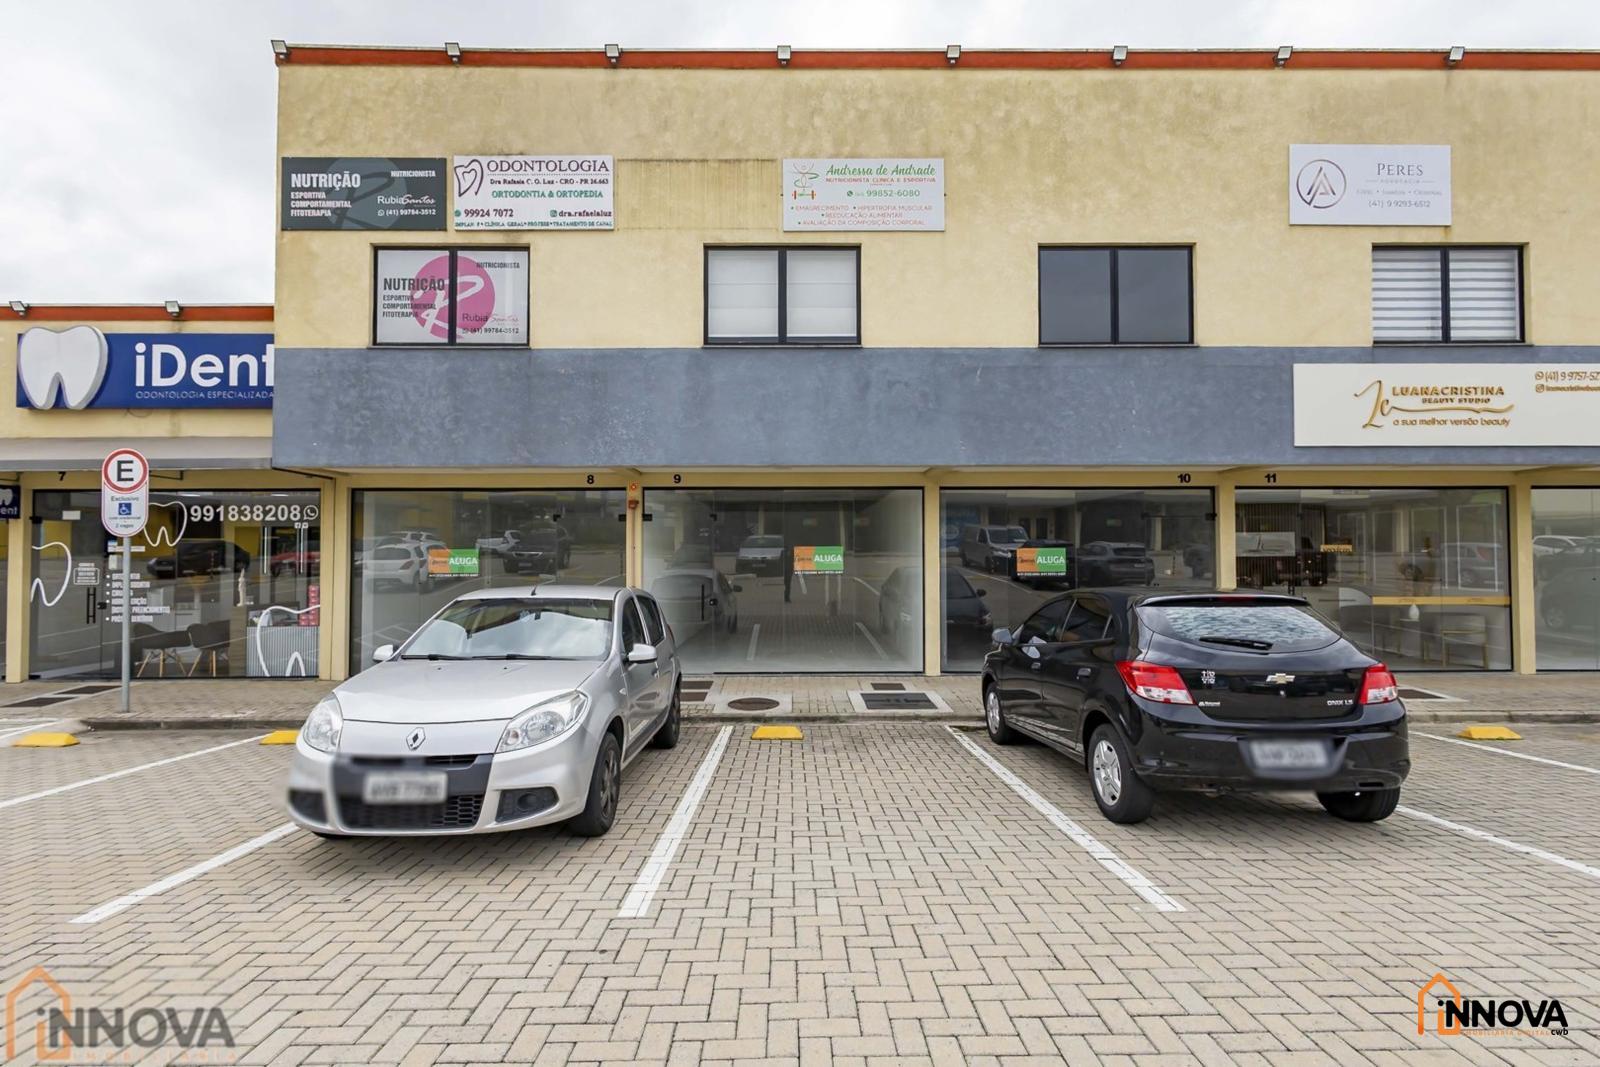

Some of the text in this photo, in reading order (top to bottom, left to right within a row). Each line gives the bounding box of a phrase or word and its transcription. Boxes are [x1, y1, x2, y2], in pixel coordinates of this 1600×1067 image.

[487, 160, 609, 172] ODONTOLOGIA
[826, 164, 936, 176] Andressa de Andrade
[1377, 163, 1423, 176] PERES
[291, 171, 361, 191] NUTRIÇÃO
[290, 192, 326, 200] ESPORTIVA
[492, 190, 603, 198] ORTODONTIA & ORTOPEDIA
[866, 189, 920, 197] 99852-6080
[401, 194, 436, 204] Santos
[386, 208, 398, 216] (41)
[464, 209, 514, 218] 99924 7072
[384, 276, 444, 293] NUTRIÇÃO
[462, 313, 488, 322] Rubia
[134, 342, 274, 387] iDent
[1560, 371, 1566, 380] 9
[136, 390, 274, 399] ODONTOLOGIA ESPECIALIZADA
[1392, 386, 1504, 396] LUANACRISTINA
[1450, 418, 1479, 426] versão
[1480, 418, 1510, 428] beauty
[118, 460, 134, 481] E
[58, 472, 66, 481] 7
[586, 474, 594, 485] 8
[673, 474, 682, 484] 9
[1177, 474, 1191, 484] 10
[1264, 473, 1276, 483] 11
[0, 506, 18, 515] ent
[190, 505, 300, 522] 991838208
[449, 556, 478, 564] ALUGA
